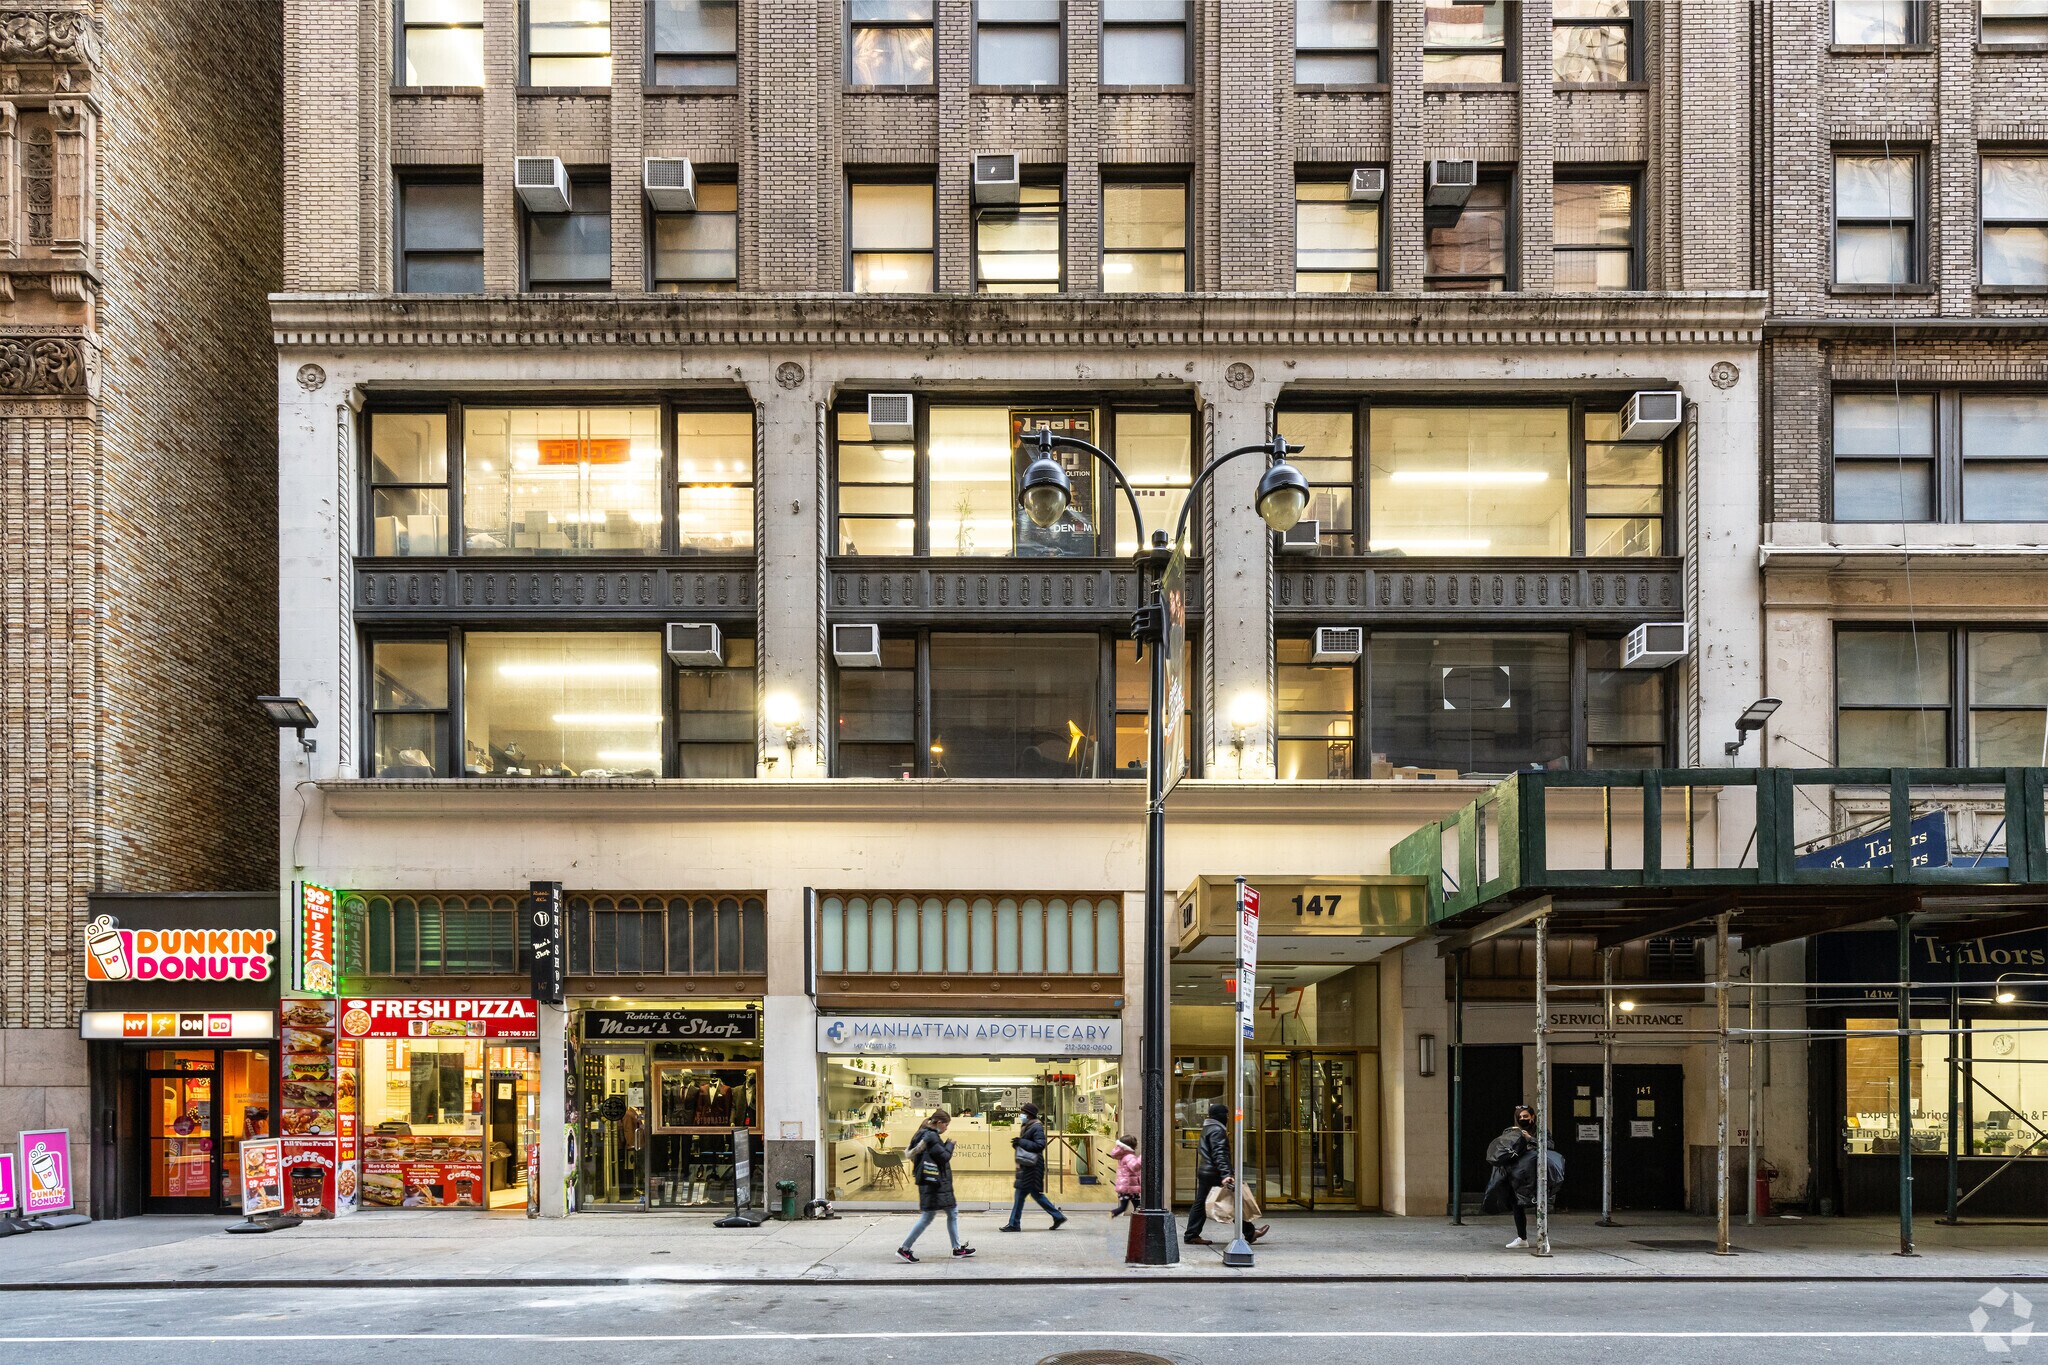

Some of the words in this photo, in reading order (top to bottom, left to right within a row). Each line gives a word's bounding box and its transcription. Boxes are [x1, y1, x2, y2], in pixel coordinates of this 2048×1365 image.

[1864, 831, 1928, 859] Tairs
[307, 902, 329, 914] FRESH
[1291, 894, 1342, 916] 147
[310, 911, 325, 960] PIZZA
[137, 931, 273, 955] DUNKIN'
[105, 955, 119, 965] DD
[137, 956, 267, 980] DONUTS
[371, 1000, 449, 1018] FRESH
[456, 1000, 526, 1018] PIZZA
[1258, 986, 1304, 1019] 47
[625, 1012, 661, 1020] Robbie
[663, 1012, 672, 1020] &
[672, 1012, 687, 1020] Co.
[1550, 1014, 1605, 1025] SERVIC
[1616, 1014, 1684, 1025] ENTRANCE
[126, 1020, 145, 1030] NY
[182, 1020, 202, 1030] ON
[213, 1021, 226, 1030] DD
[599, 1018, 670, 1034] Men's
[679, 1018, 742, 1038] Shop
[854, 1022, 969, 1038] MANHATTAN
[976, 1024, 1111, 1040] APOTHECARY
[1636, 1086, 1651, 1094] 147
[1856, 1129, 1880, 1138] Fine
[2018, 1130, 2038, 1141] Day
[282, 1151, 334, 1168] Coffee
[447, 1170, 480, 1181] Coffee
[31, 1188, 64, 1198] DUNKIN'
[32, 1196, 64, 1206] DONUTS
